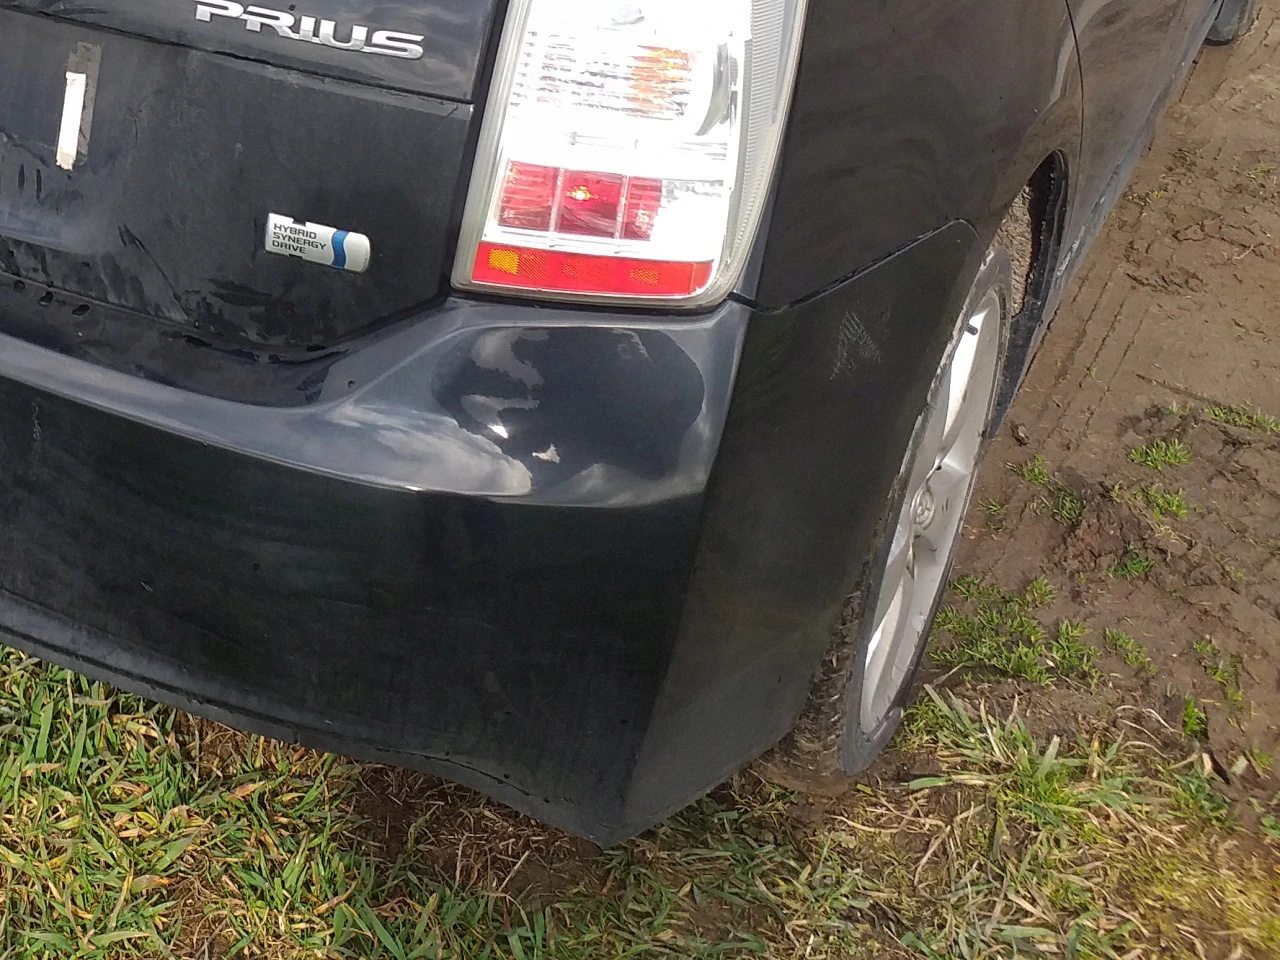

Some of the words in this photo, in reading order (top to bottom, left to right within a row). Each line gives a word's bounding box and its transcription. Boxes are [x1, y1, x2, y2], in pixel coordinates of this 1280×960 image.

[273, 223, 317, 240] HYBRID
[272, 231, 327, 251] SYNERGY
[272, 240, 306, 254] DRIVE
